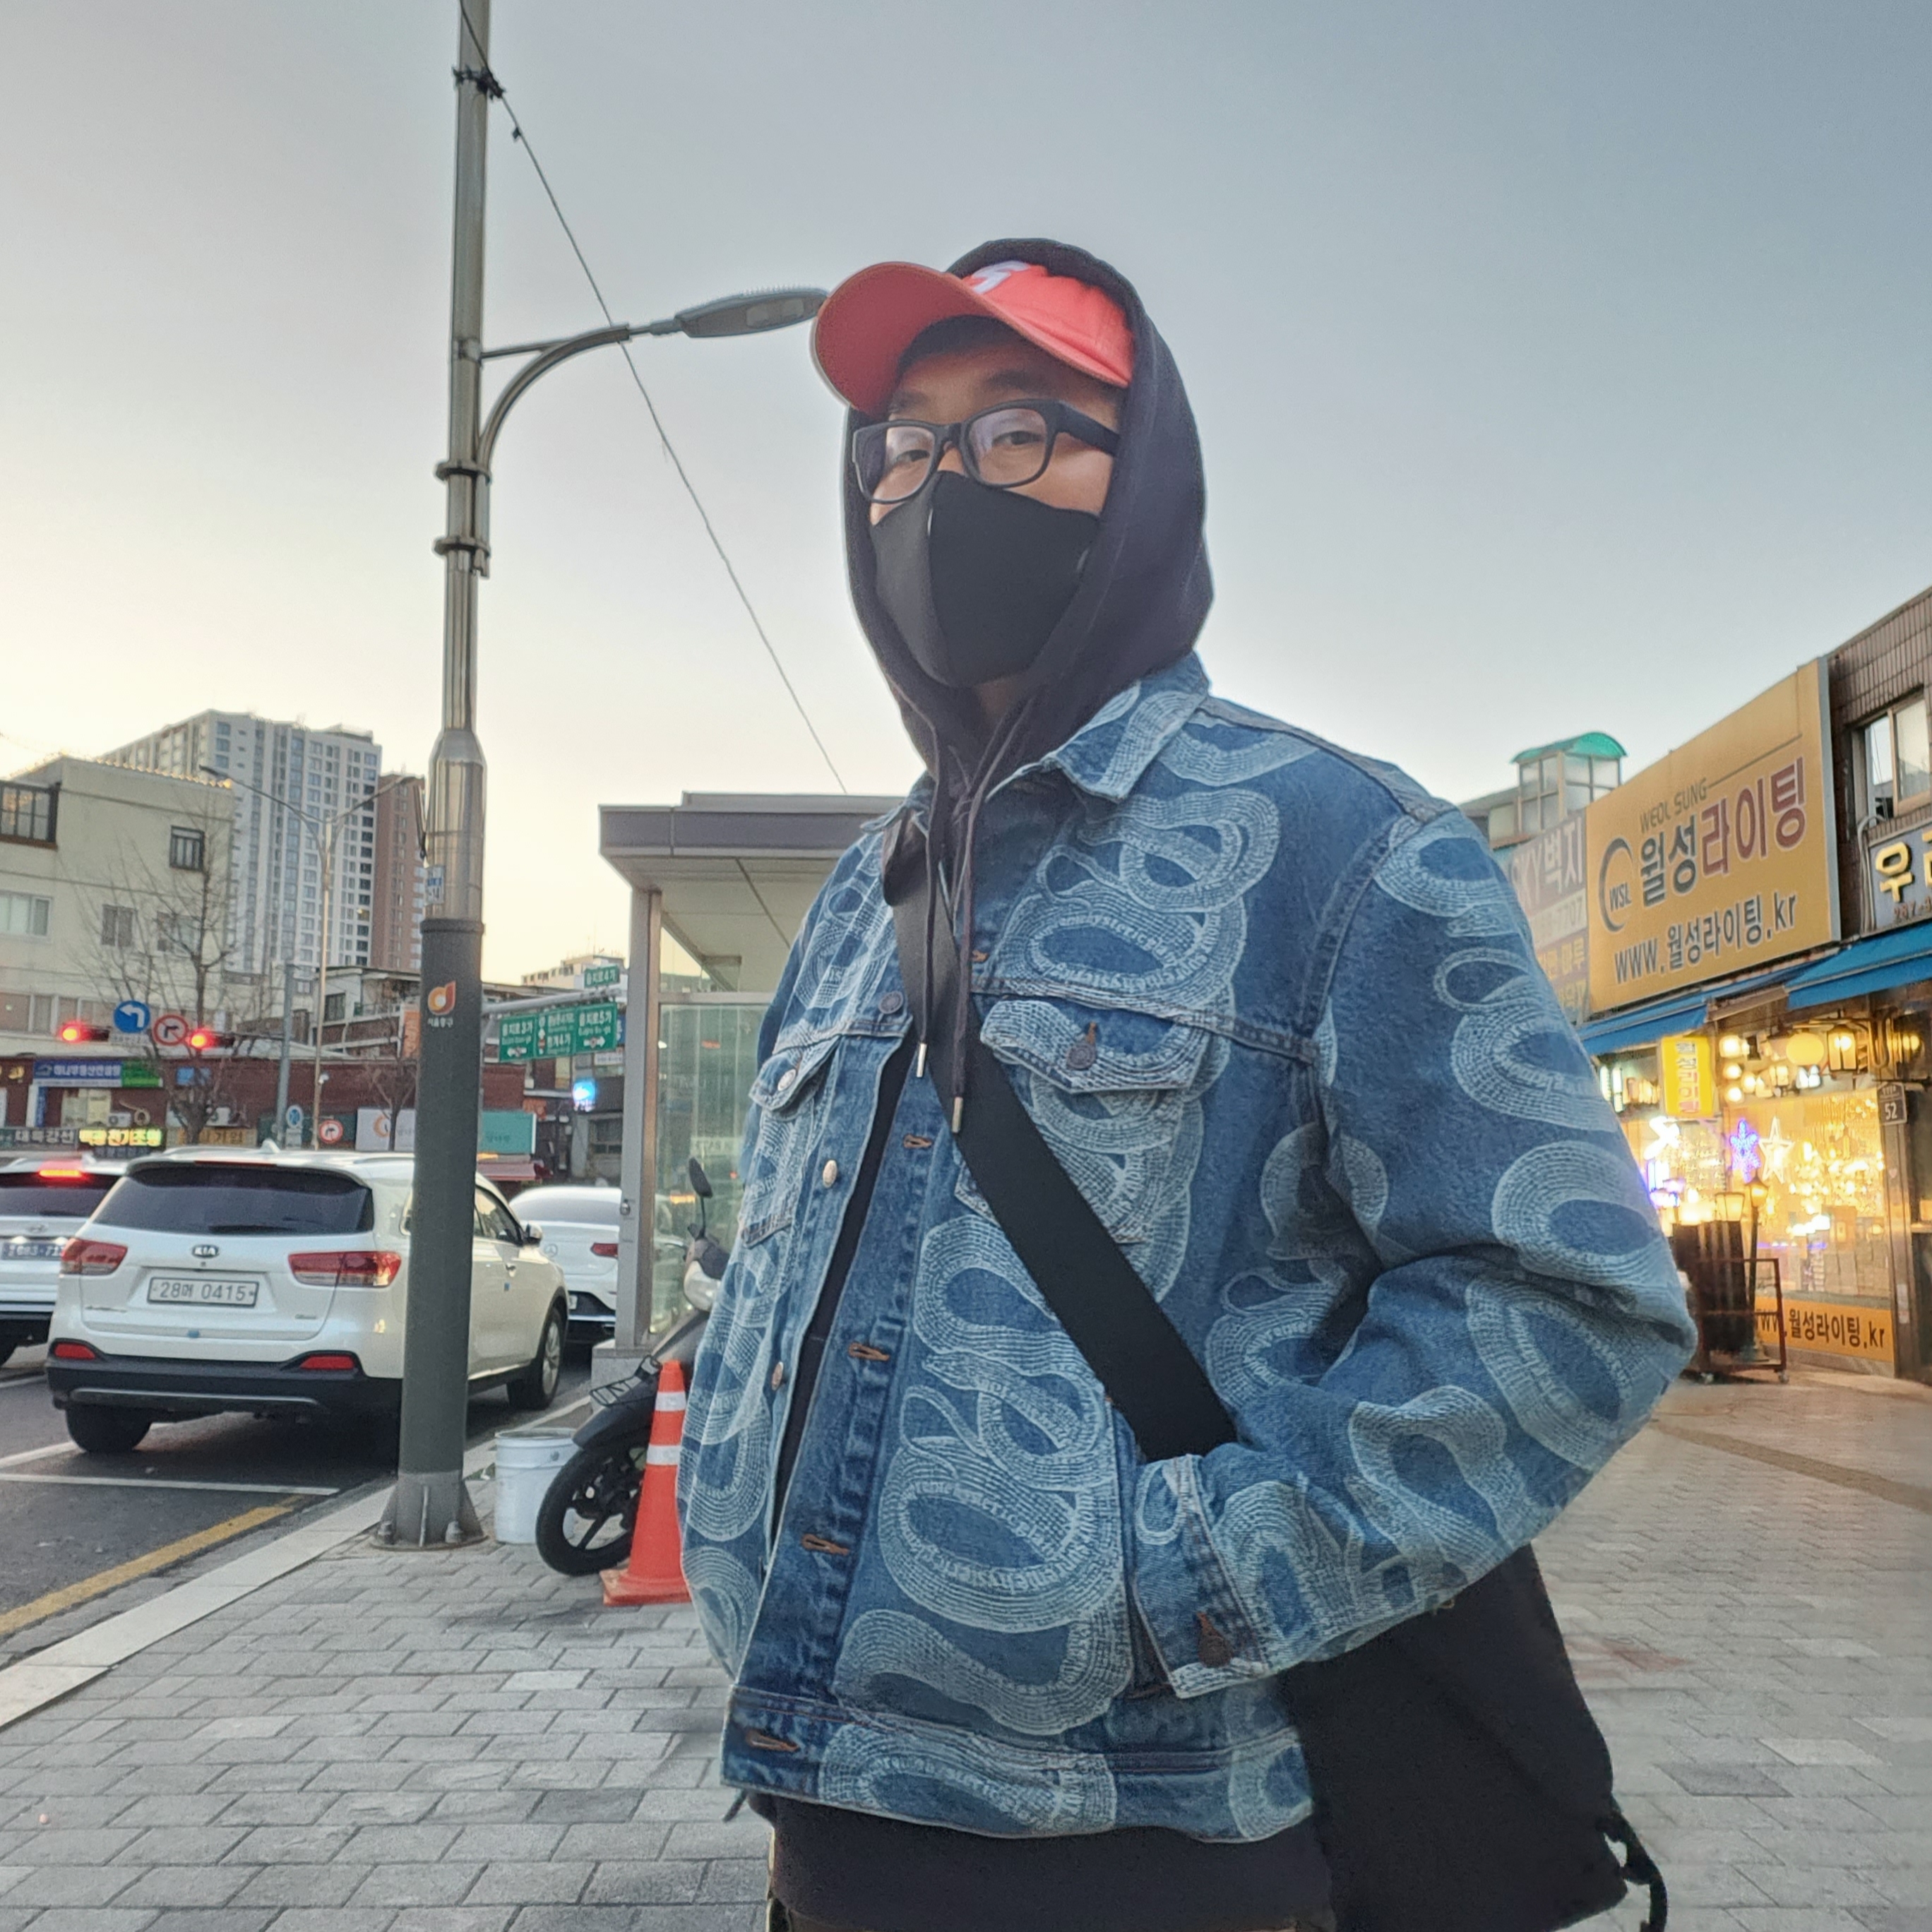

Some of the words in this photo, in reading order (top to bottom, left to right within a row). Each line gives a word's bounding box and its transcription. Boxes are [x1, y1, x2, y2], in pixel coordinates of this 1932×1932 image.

[1639, 801, 1671, 834] WEOL
[1674, 777, 1708, 815] SUNG
[1640, 756, 1806, 908] 월성라이팅
[1609, 882, 1633, 912] WSL
[579, 1010, 612, 1027] 을지로5가
[1885, 1102, 1897, 1120] 52
[194, 1245, 216, 1256] KIA
[201, 1283, 247, 1301] 0415
